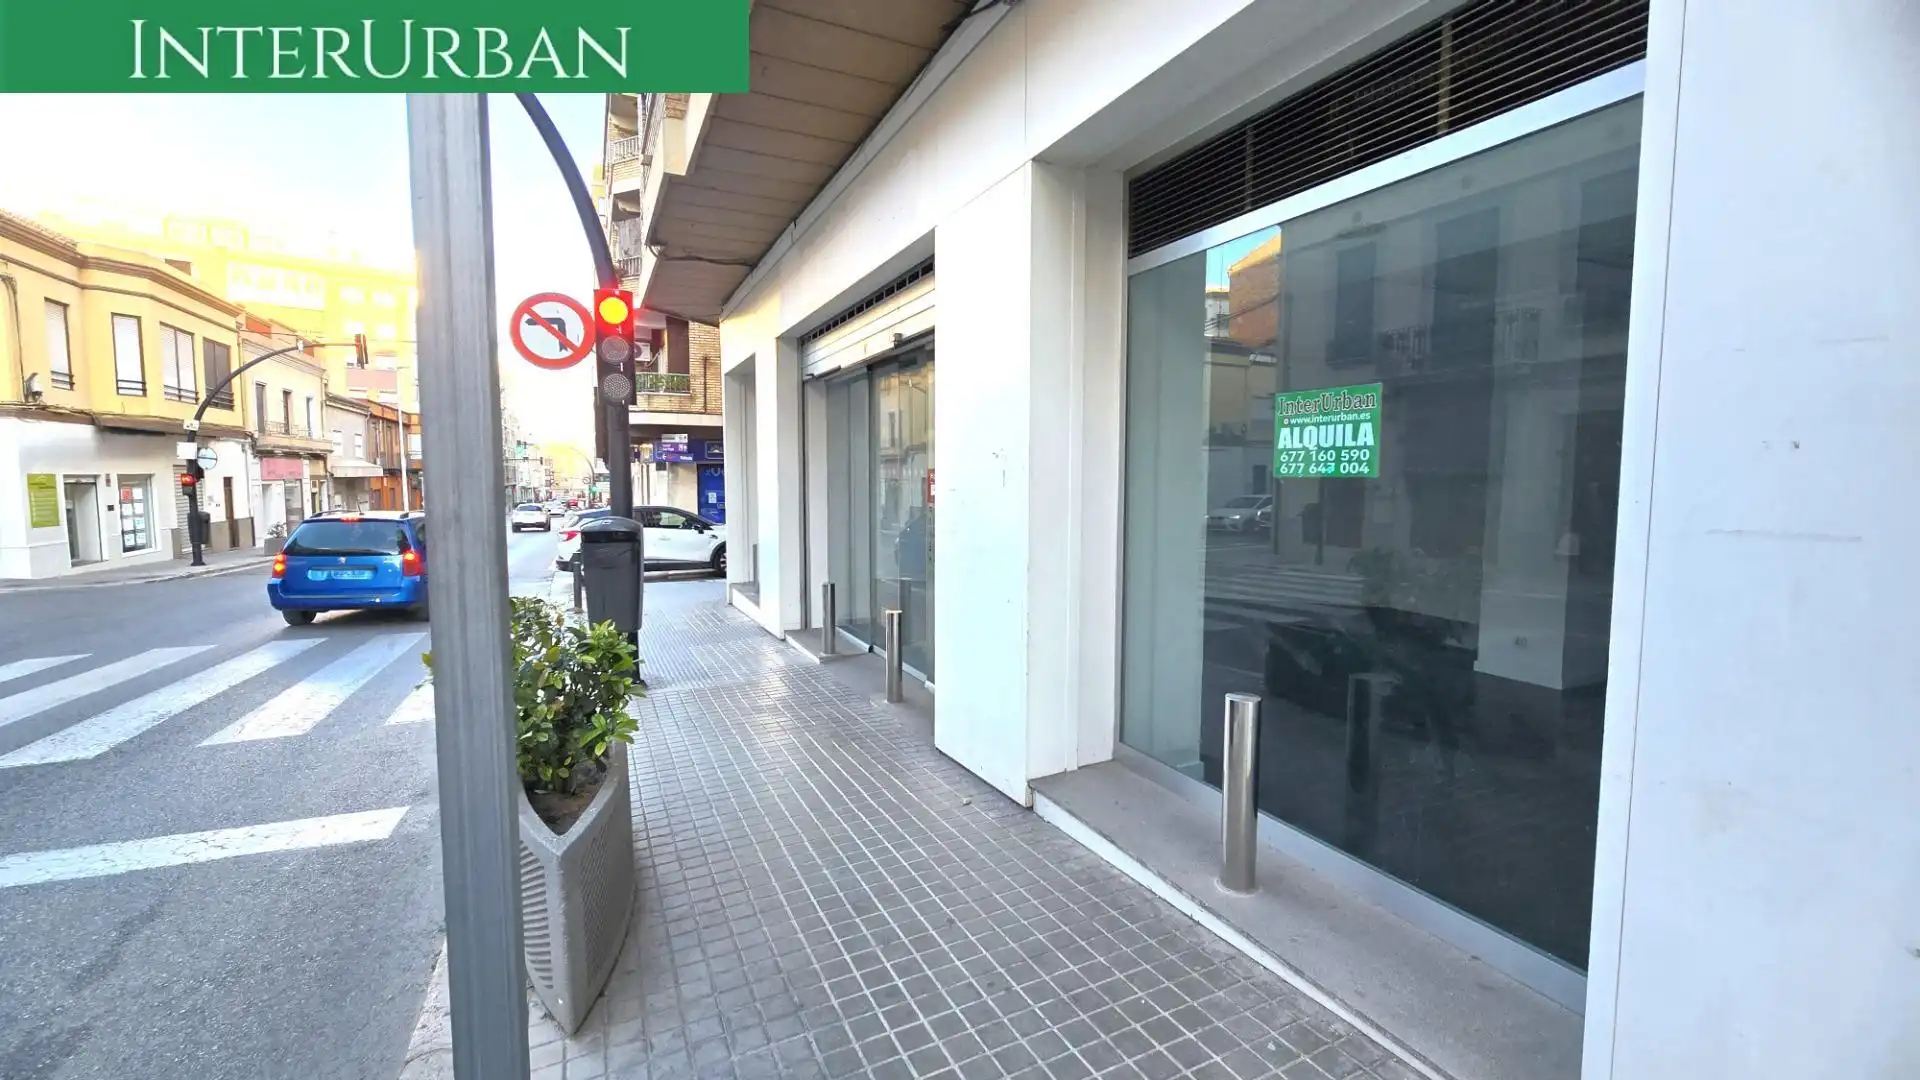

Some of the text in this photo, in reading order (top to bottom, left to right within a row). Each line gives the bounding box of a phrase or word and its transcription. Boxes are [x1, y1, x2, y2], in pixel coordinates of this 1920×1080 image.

[1278, 390, 1376, 416] InterUrban
[1290, 412, 1371, 424] www.interurban.es
[1277, 422, 1375, 450] ALQUILA
[1280, 449, 1370, 462] 677 160 590
[1280, 463, 1305, 474] 677
[1340, 462, 1370, 474] 004
